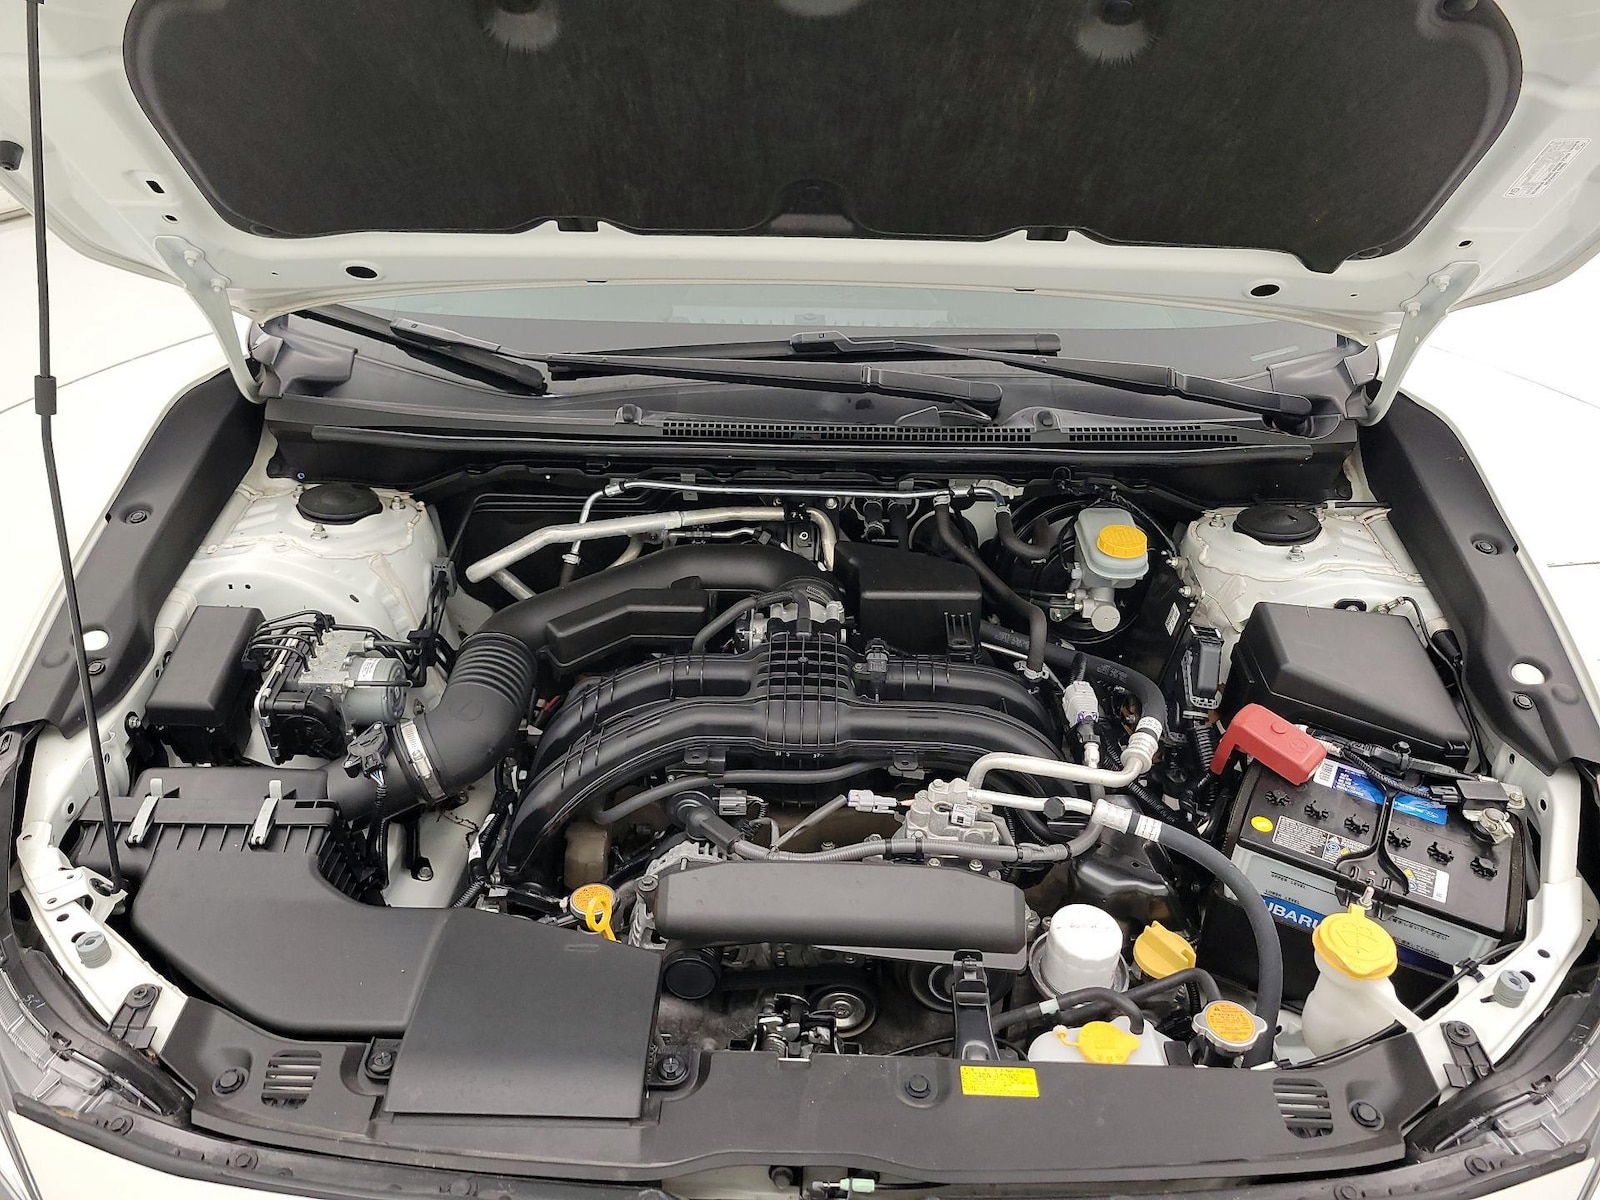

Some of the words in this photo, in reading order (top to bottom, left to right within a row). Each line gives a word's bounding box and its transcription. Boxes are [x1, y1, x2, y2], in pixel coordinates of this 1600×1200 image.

[1271, 873, 1288, 882] UPPER
[1290, 880, 1306, 889] LEVEL
[1265, 889, 1282, 898] LOWER
[1284, 896, 1300, 905] LEVEL
[1264, 899, 1319, 930] UBAR
